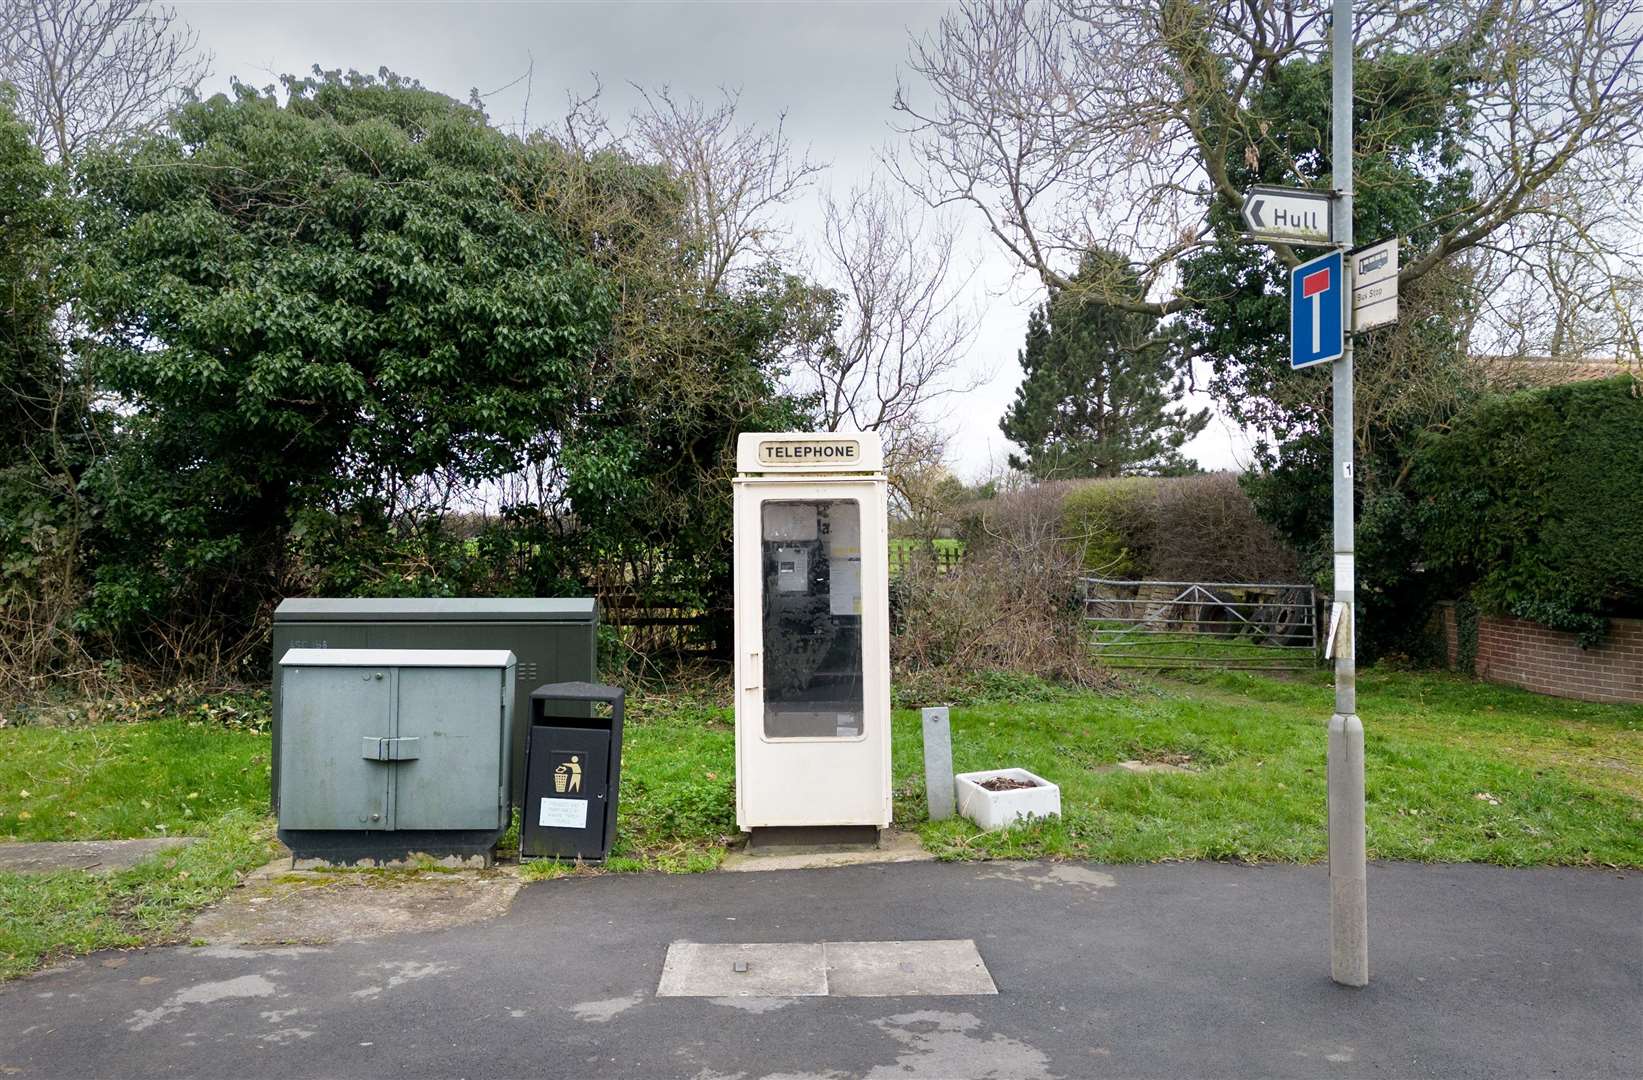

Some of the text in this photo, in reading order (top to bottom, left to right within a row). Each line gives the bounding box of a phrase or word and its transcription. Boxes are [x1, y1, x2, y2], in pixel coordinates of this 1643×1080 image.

[1274, 208, 1317, 229] Hull
[1369, 287, 1383, 299] Stop
[766, 446, 854, 458] TELEPHONE
[1346, 463, 1352, 476] 1
